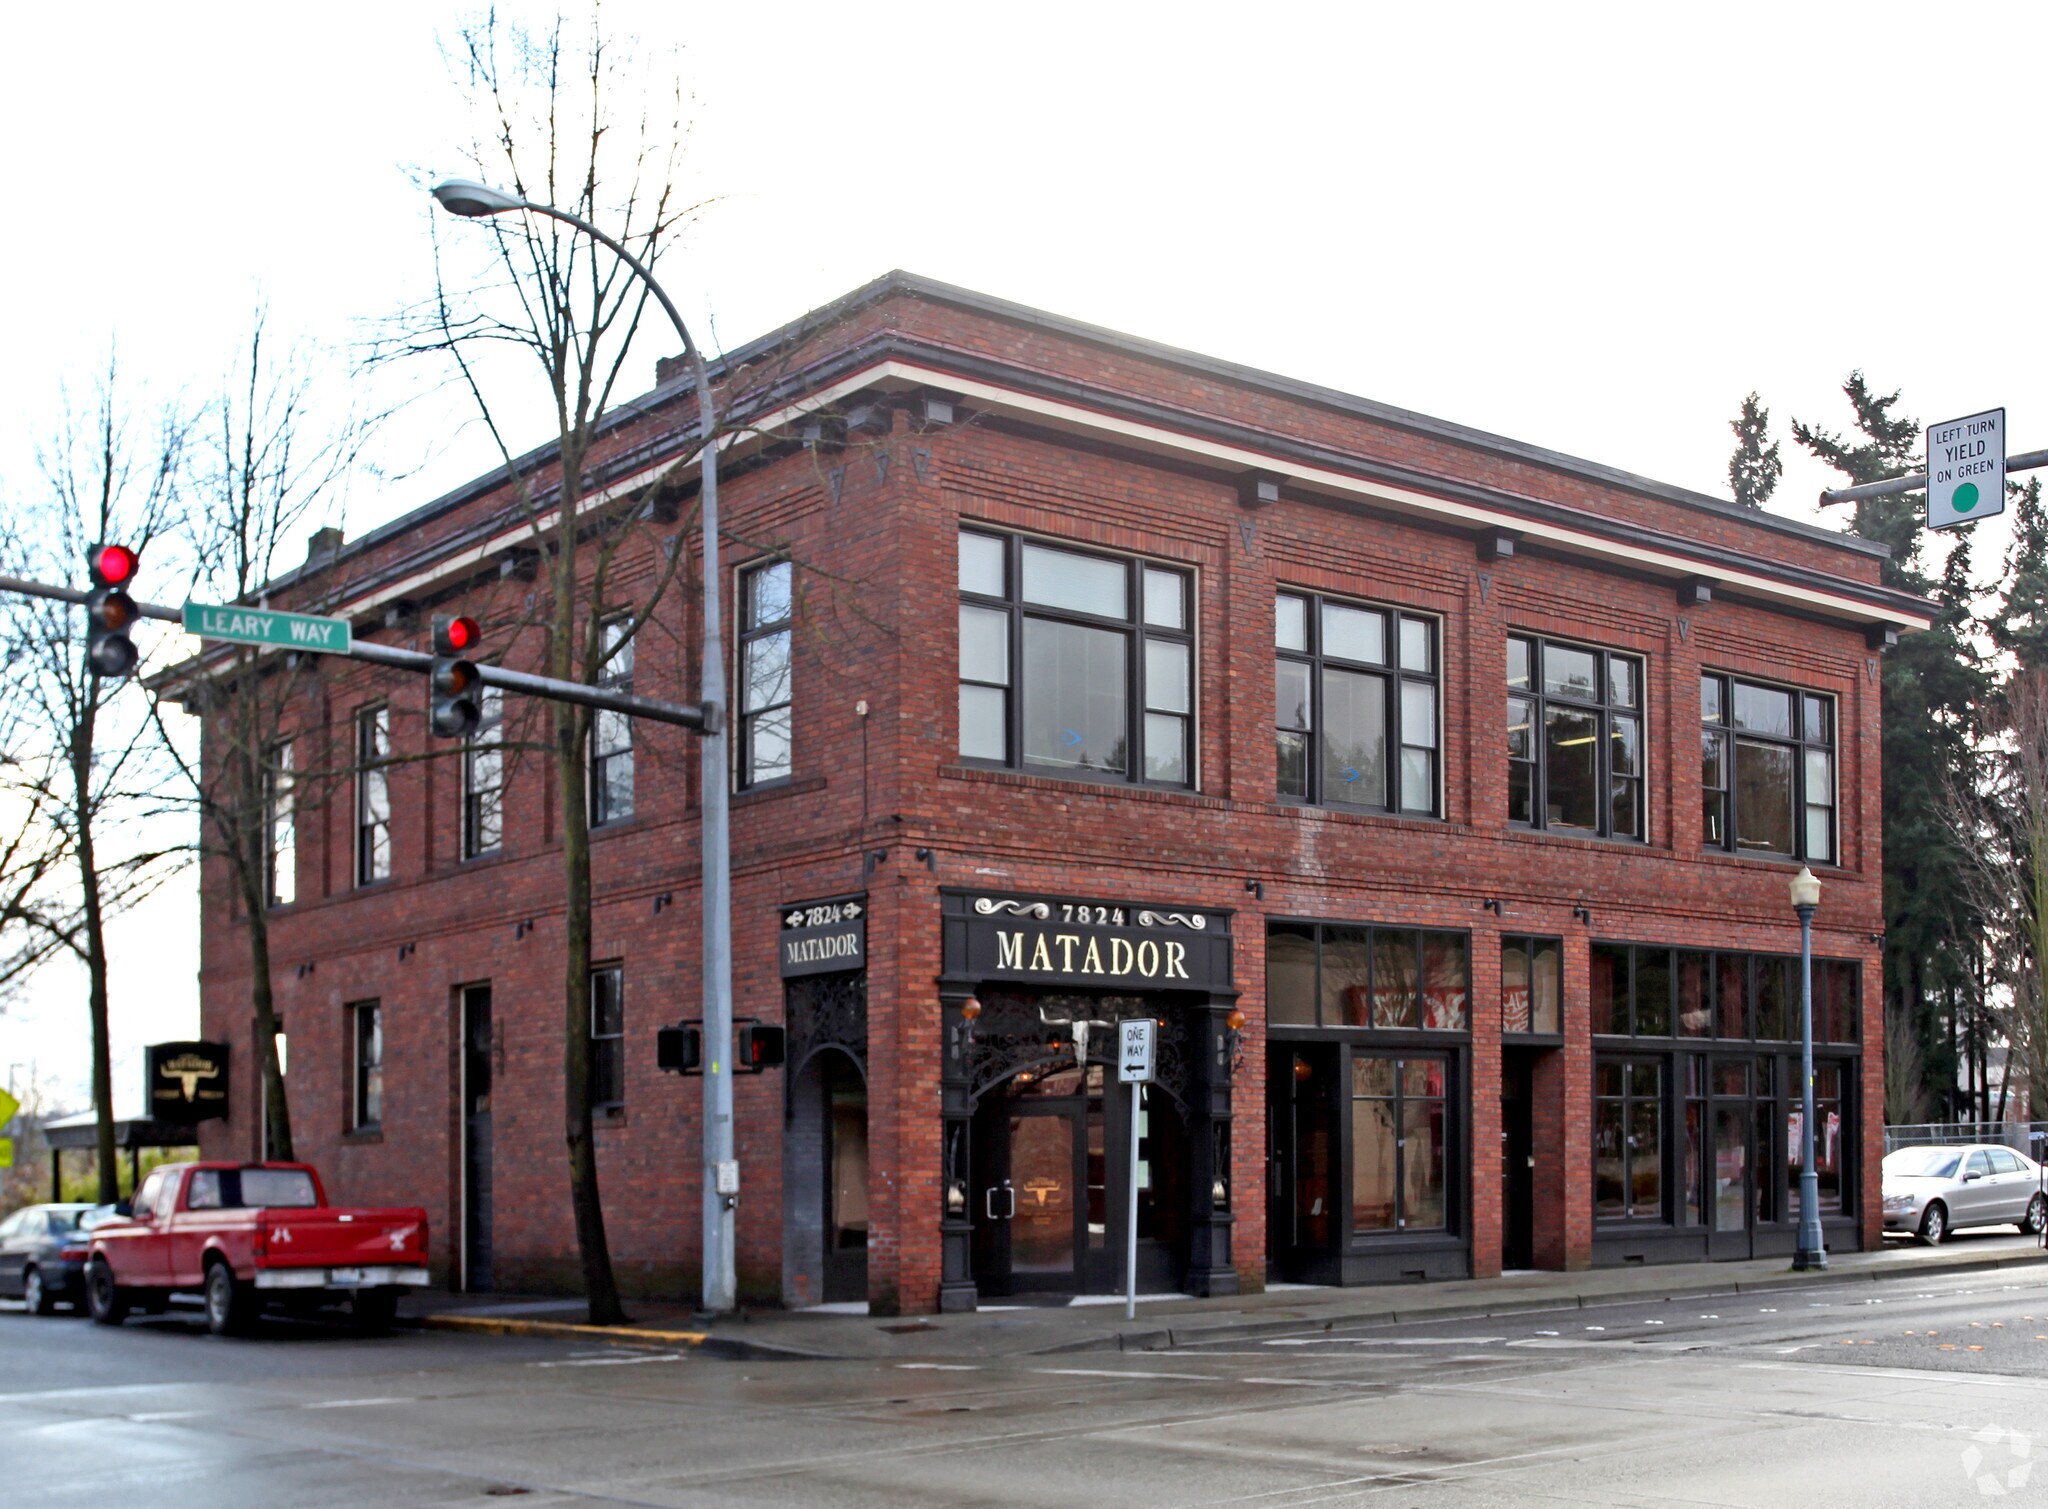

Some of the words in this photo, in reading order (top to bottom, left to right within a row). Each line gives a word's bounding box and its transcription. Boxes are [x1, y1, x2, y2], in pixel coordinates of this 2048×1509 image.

[1936, 426, 1962, 445] LEFT
[1966, 419, 1995, 437] TURN
[1945, 440, 1986, 463] YIELD
[1936, 469, 1952, 483] ON
[1957, 459, 1994, 479] GREEN
[202, 610, 274, 637] LEARY
[290, 621, 333, 644] WAY
[805, 903, 841, 927] 7824
[1061, 904, 1125, 927] 7824
[787, 933, 859, 964] MATADOR
[996, 930, 1190, 980] MATADOR
[1127, 1028, 1144, 1041] ONE
[1127, 1044, 1145, 1057] WAY
